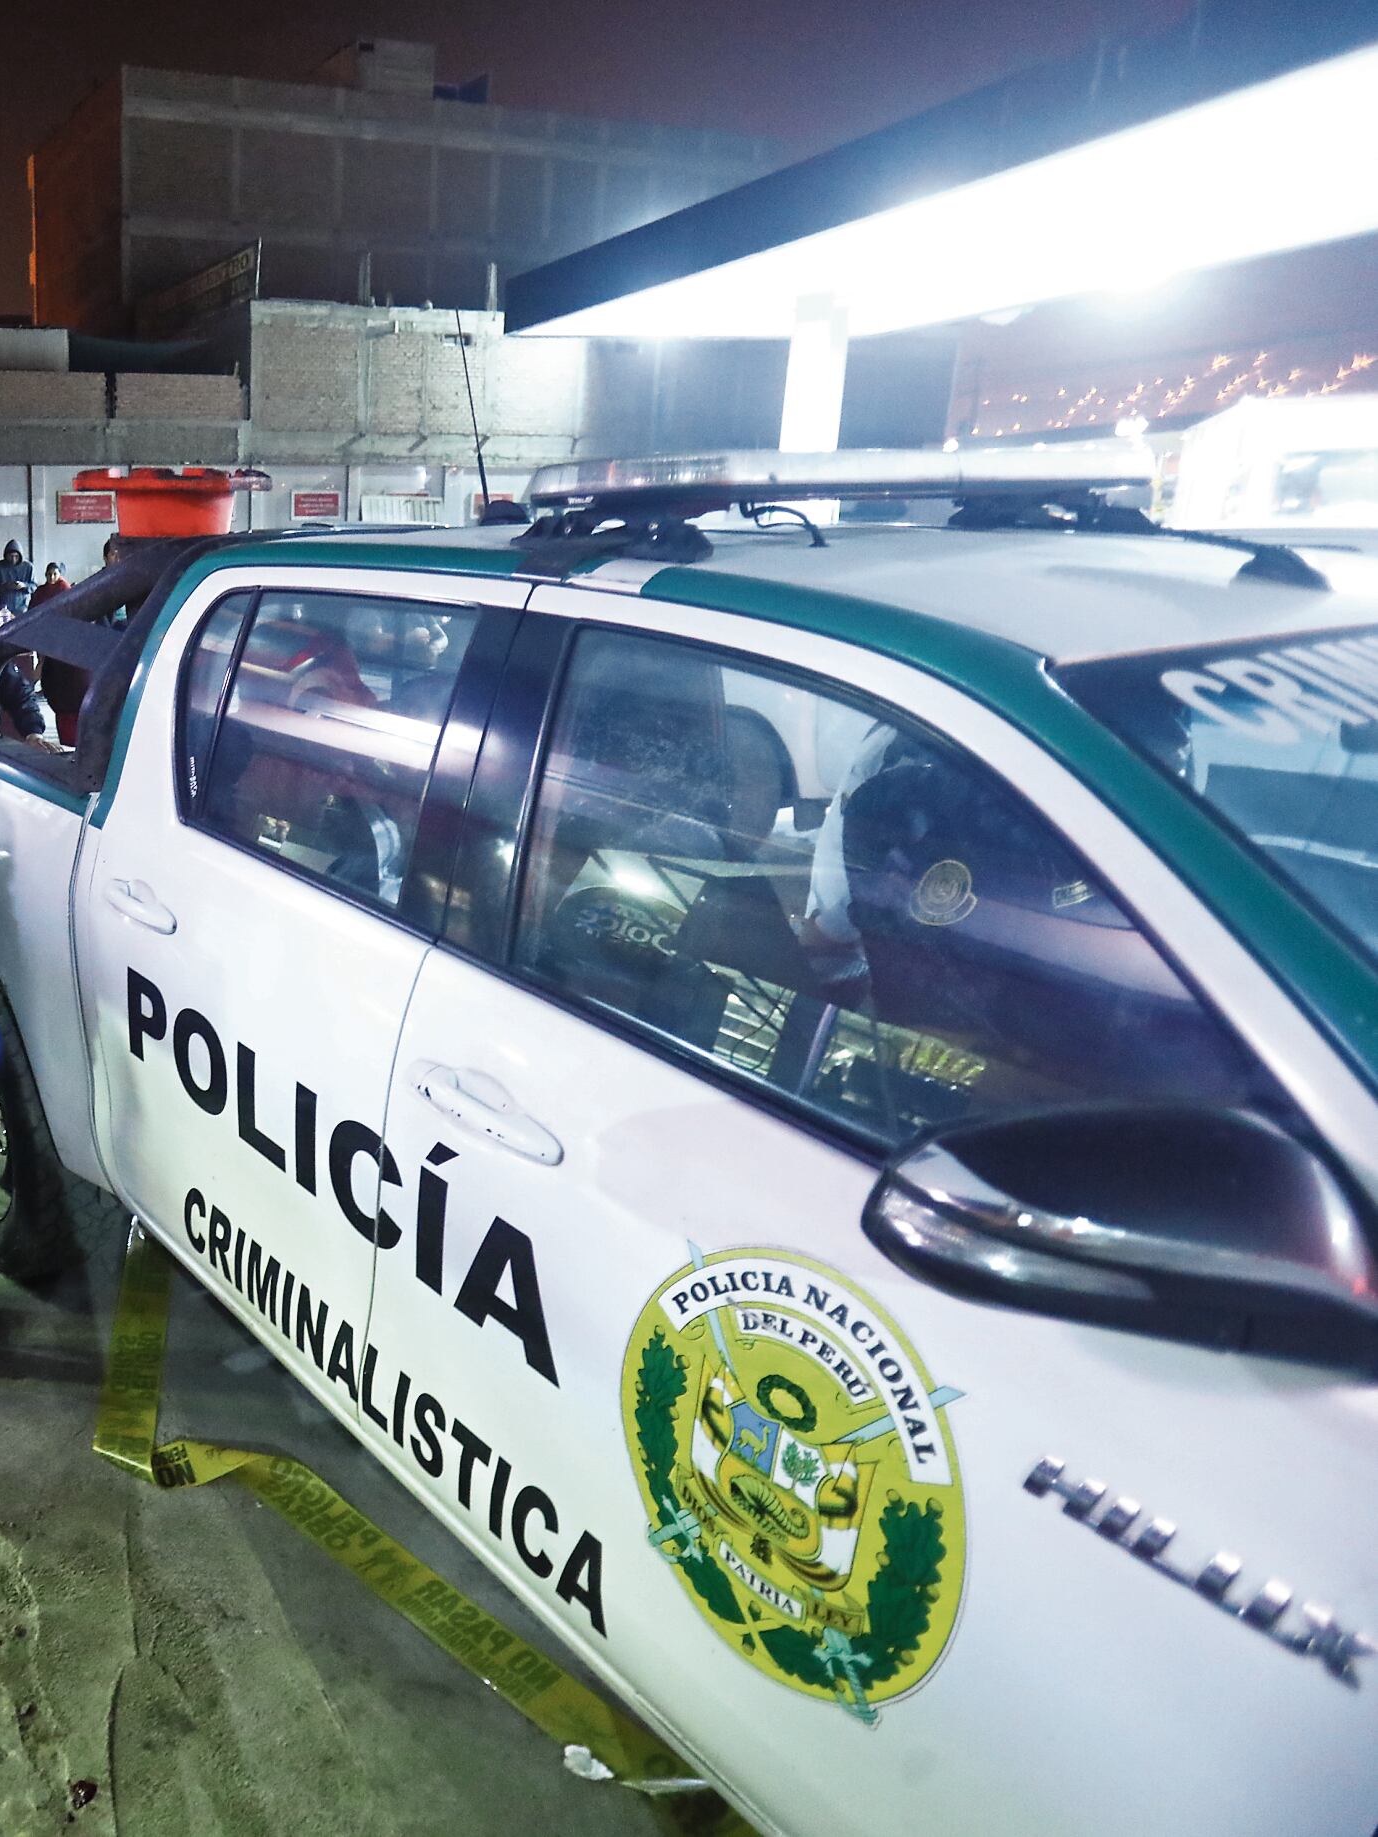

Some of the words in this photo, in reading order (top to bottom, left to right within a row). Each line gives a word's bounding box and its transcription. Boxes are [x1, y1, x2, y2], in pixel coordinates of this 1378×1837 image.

[127, 965, 560, 1389] POLICÍA
[184, 1187, 608, 1639] CRIMINALISTICA
[672, 1271, 795, 1315] POLICIA
[803, 1283, 937, 1464] NACIONAL
[742, 1311, 794, 1337] DEL
[798, 1326, 871, 1398] PERÚ
[725, 1550, 795, 1614] PATRIA
